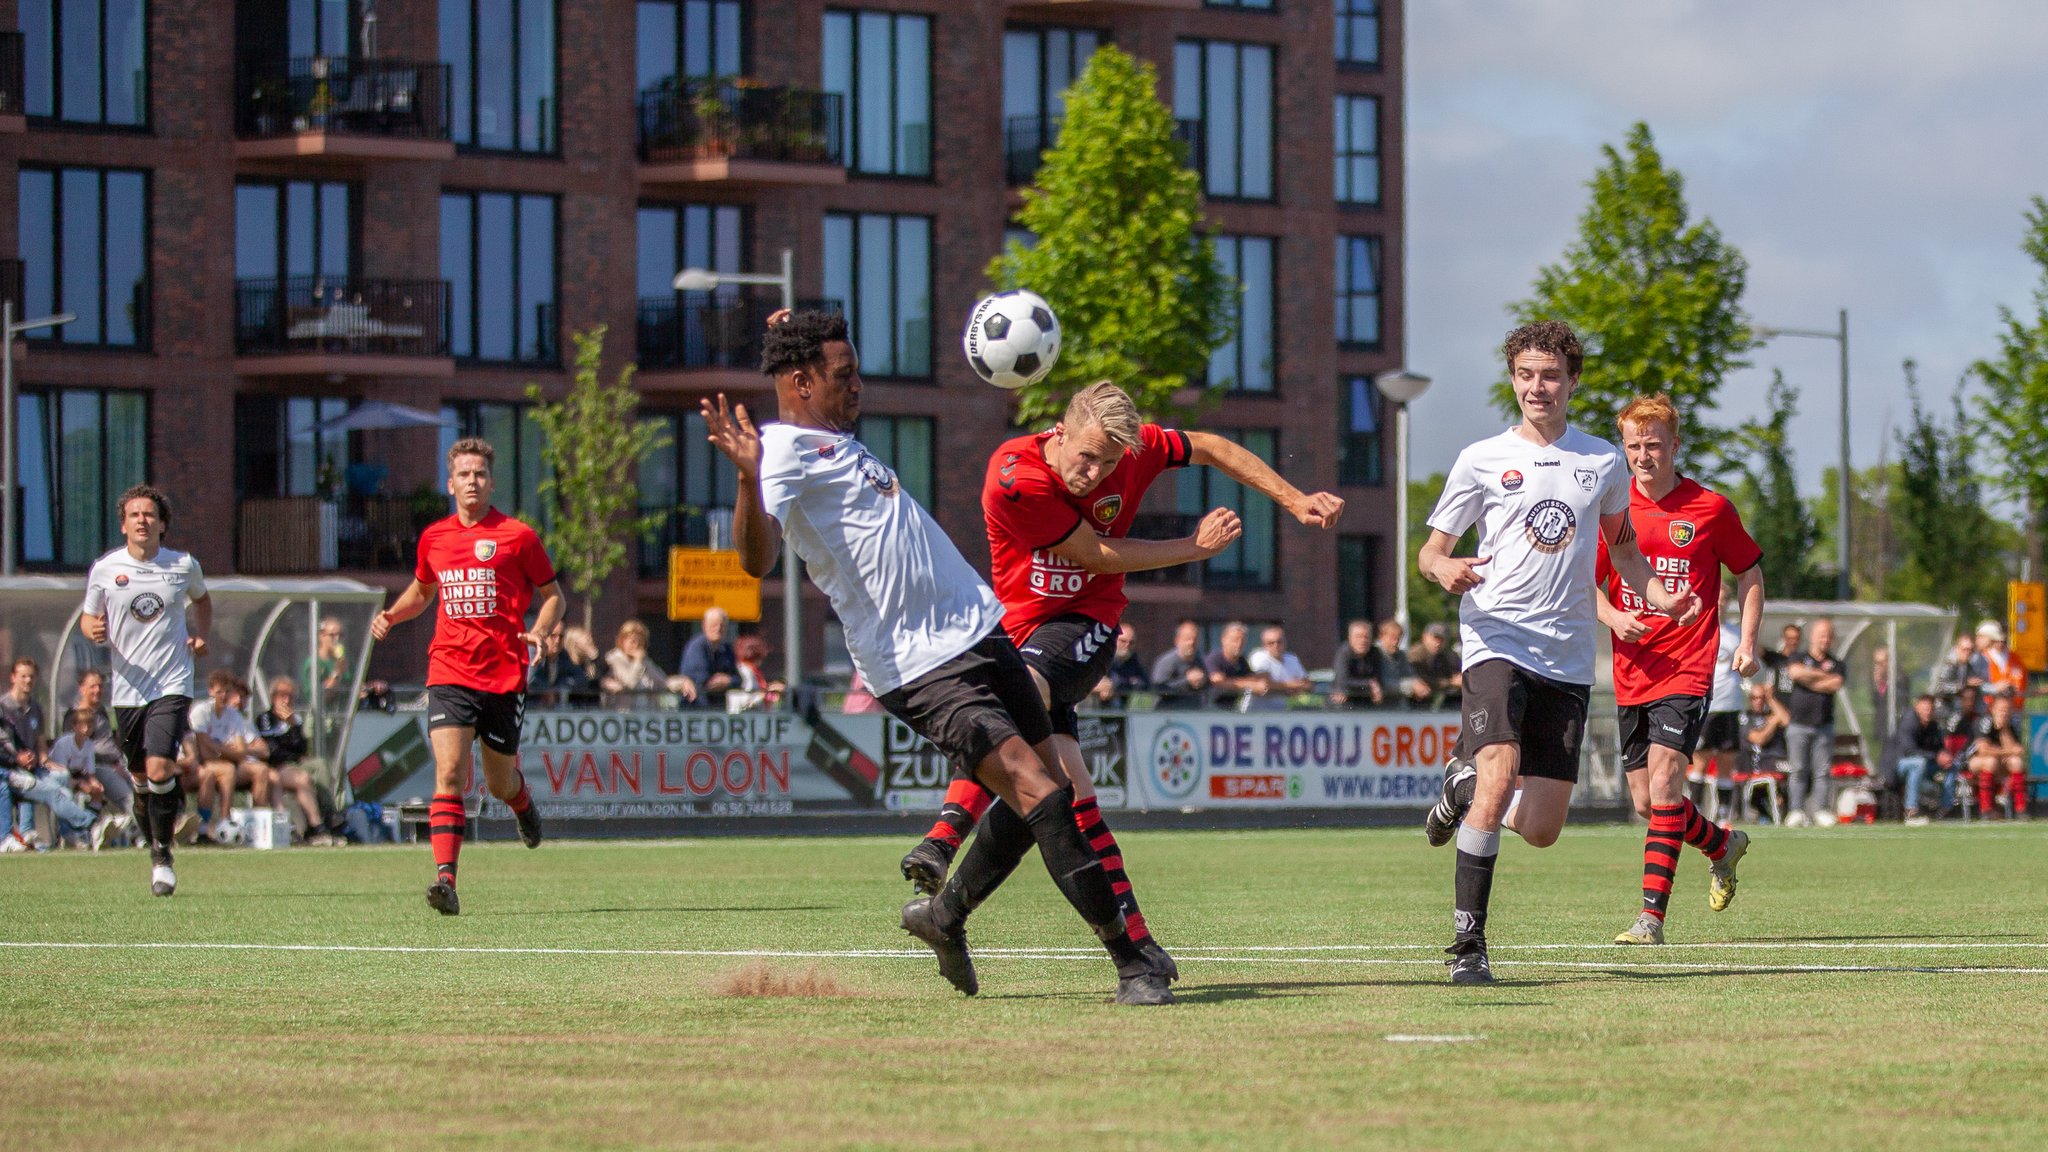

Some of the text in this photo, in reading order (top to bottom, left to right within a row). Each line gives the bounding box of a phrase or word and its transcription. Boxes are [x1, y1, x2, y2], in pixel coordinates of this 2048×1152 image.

[1656, 557, 1690, 573] DER
[438, 568, 496, 583] VAN DER
[442, 585, 496, 600] LINDEN
[446, 602, 497, 615] GROEP
[1662, 724, 1683, 736] hummel
[1210, 725, 1461, 767] DE ROOIJ GROE
[541, 751, 642, 797] VAN
[656, 750, 792, 797] LOON
[1223, 776, 1285, 797] SPAR
[1322, 775, 1444, 798] WWW.DEROO
